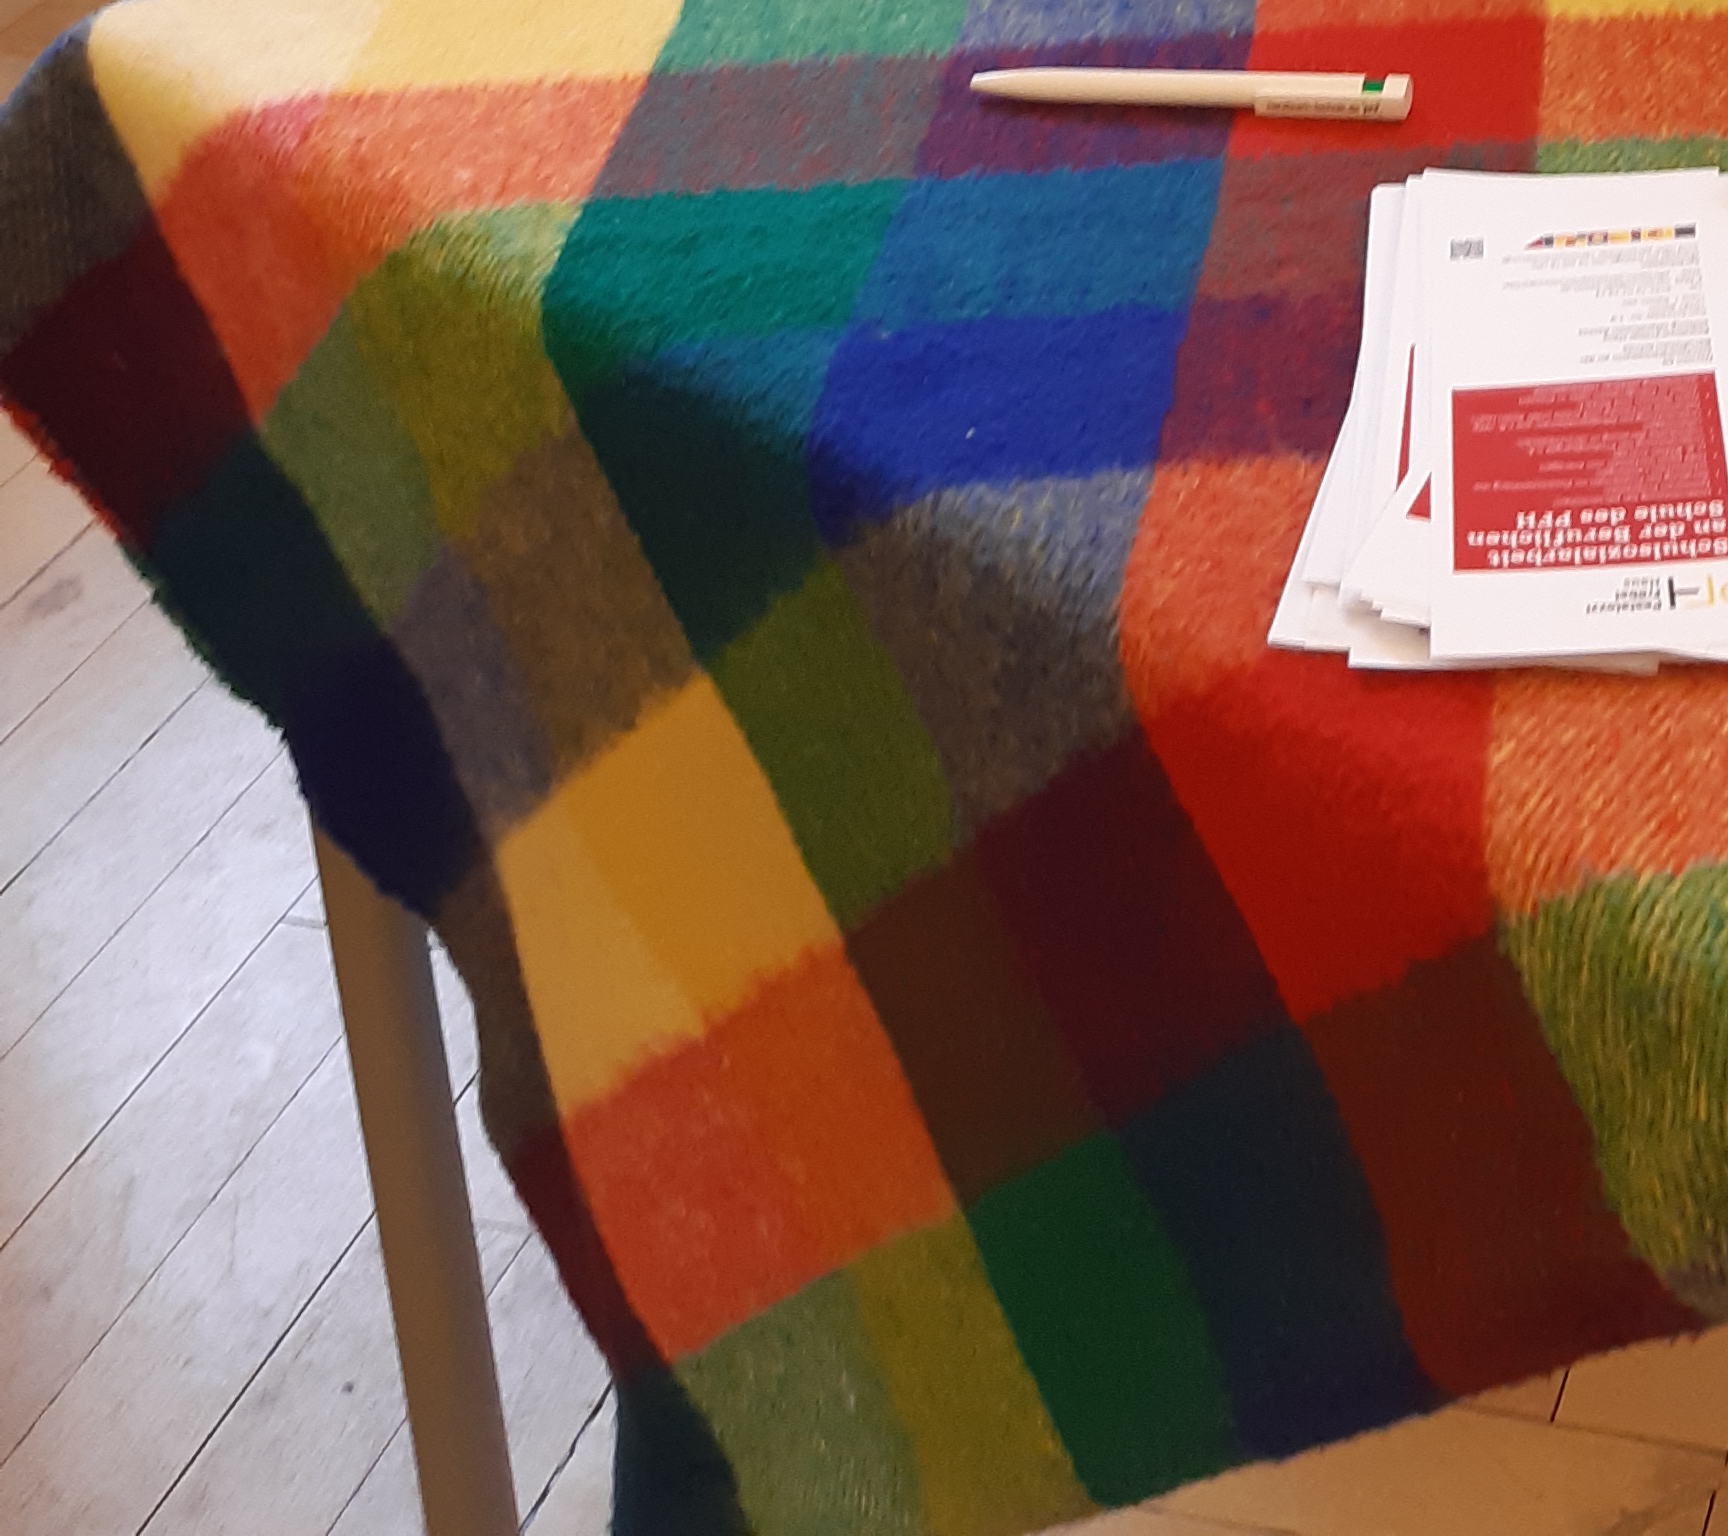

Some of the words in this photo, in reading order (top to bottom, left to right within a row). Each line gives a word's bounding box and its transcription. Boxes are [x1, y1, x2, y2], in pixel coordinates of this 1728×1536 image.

[1516, 509, 1572, 529] PFH
[1580, 505, 1627, 526] des
[1634, 499, 1725, 523] Schule
[1638, 521, 1685, 540] der
[1694, 518, 1726, 534] an
[1487, 536, 1728, 568] Schulsozialarbeit
